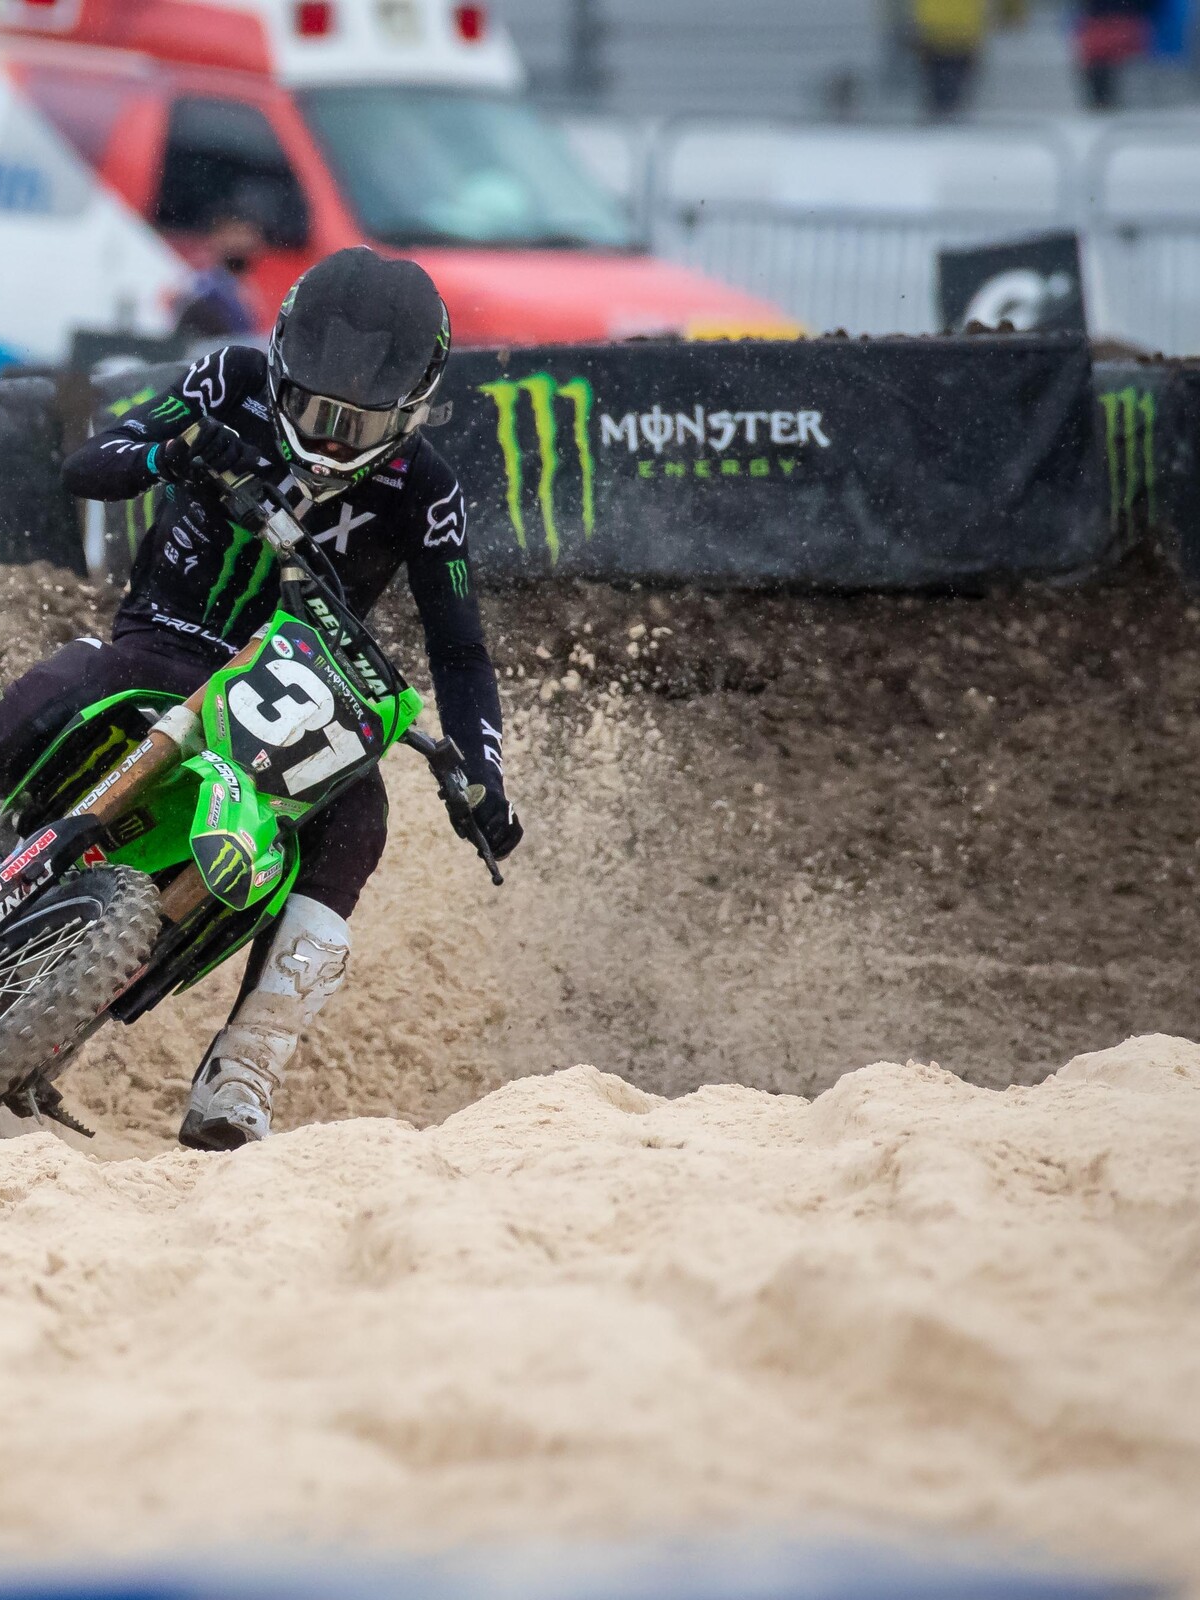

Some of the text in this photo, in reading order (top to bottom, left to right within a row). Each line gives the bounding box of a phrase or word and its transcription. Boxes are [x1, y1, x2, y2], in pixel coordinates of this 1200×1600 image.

[600, 404, 831, 454] MONSTER
[151, 613, 202, 634] PRO
[306, 597, 390, 706] RENHA
[323, 665, 364, 720] MONSTER
[228, 658, 367, 796] 31
[70, 770, 122, 818] CIRCUI
[212, 762, 242, 803] CIRCUIT
[0, 828, 58, 882] BRAKING
